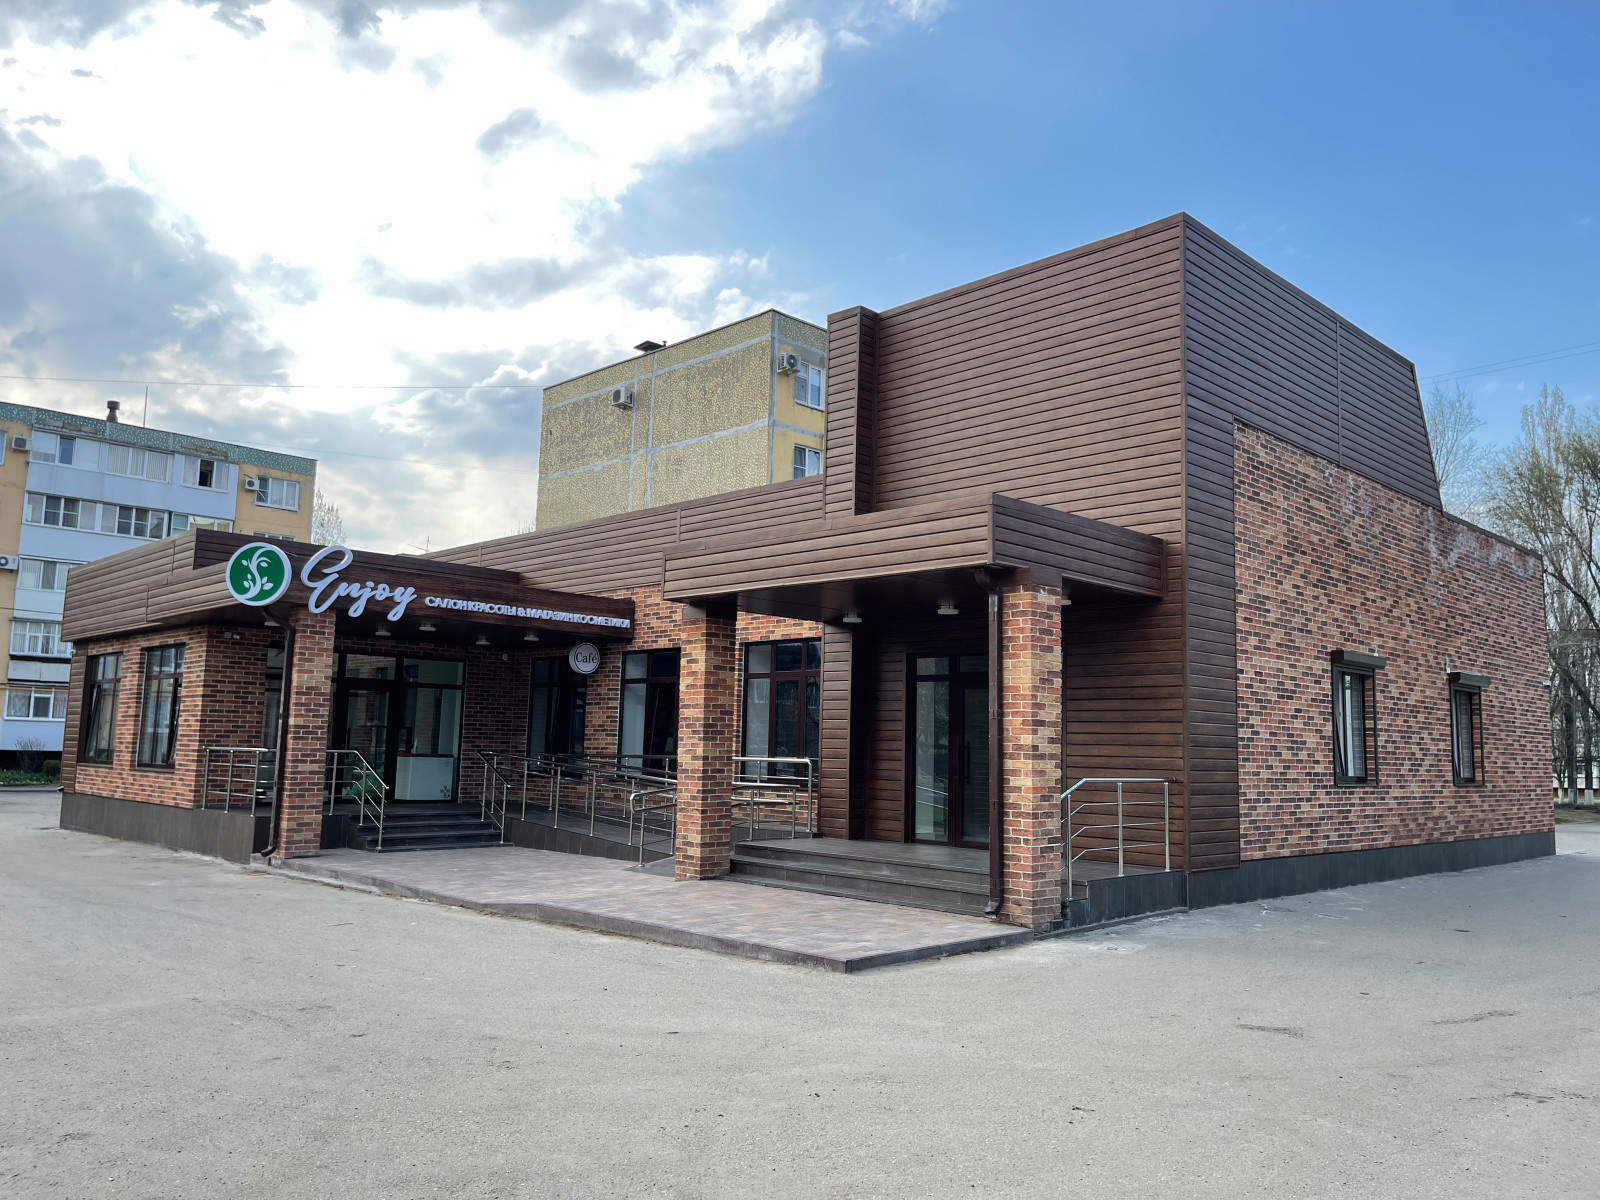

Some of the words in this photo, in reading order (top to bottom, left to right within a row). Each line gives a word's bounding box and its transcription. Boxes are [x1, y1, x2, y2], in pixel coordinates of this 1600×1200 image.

[300, 545, 418, 621] Enjoy
[424, 596, 467, 610] САЛОН
[468, 601, 516, 616] КРАСОТЫ
[517, 607, 526, 617] &
[526, 608, 573, 623] МАГАЗИН
[573, 614, 631, 628] КОСМЕТИКИ
[575, 651, 598, 664] Café
